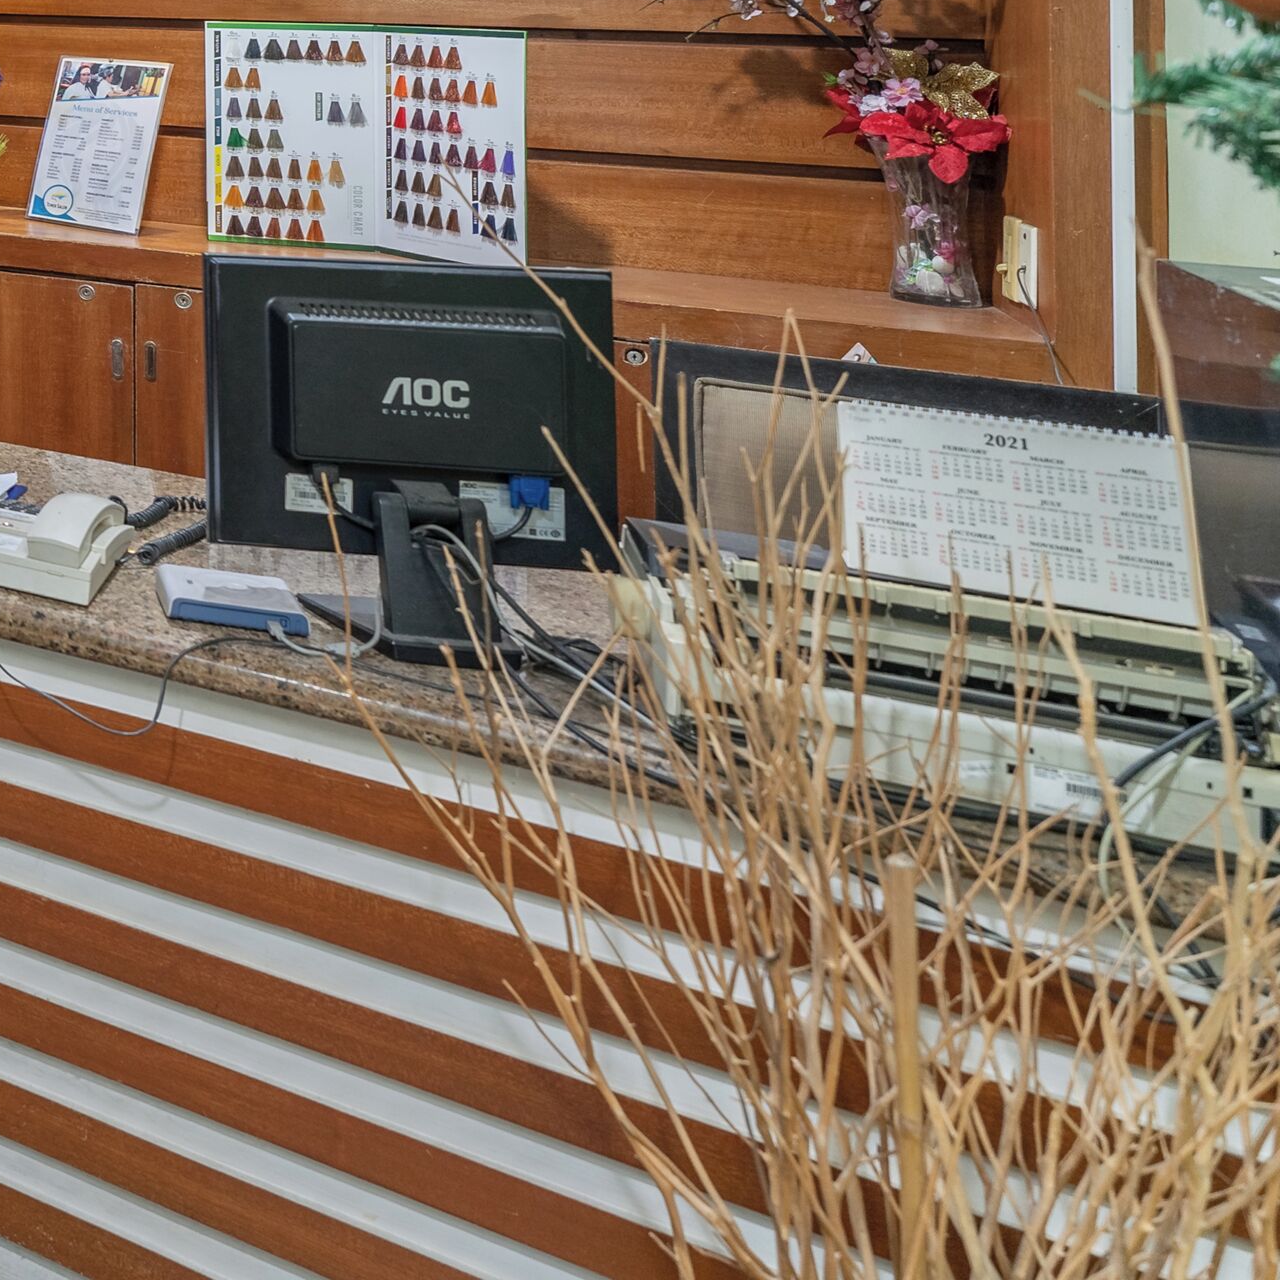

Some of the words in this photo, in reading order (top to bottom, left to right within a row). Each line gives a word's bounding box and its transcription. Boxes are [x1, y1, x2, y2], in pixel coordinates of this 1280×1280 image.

[73, 105, 94, 113] Menu
[95, 105, 103, 114] of
[104, 107, 138, 118] Services
[352, 185, 364, 209] COLOR
[352, 211, 364, 236] CHART
[381, 376, 470, 409] AOC
[381, 408, 418, 417] EYES
[424, 410, 470, 420] VALUE
[865, 434, 903, 444] JANUARY
[983, 433, 1030, 451] 2021
[942, 444, 988, 455] FEBRUARY
[1029, 455, 1065, 465] MARCH
[1120, 467, 1149, 476] APRIL
[879, 476, 899, 485] MAY
[957, 487, 980, 496] JUNE
[1040, 499, 1062, 508] JULY
[1119, 510, 1158, 521] AUGUST
[865, 516, 918, 529] SEPTEMBER
[950, 529, 997, 541] OCTOBER
[1029, 540, 1084, 554] NOVEMBER
[1117, 553, 1174, 568] DECEMBER
